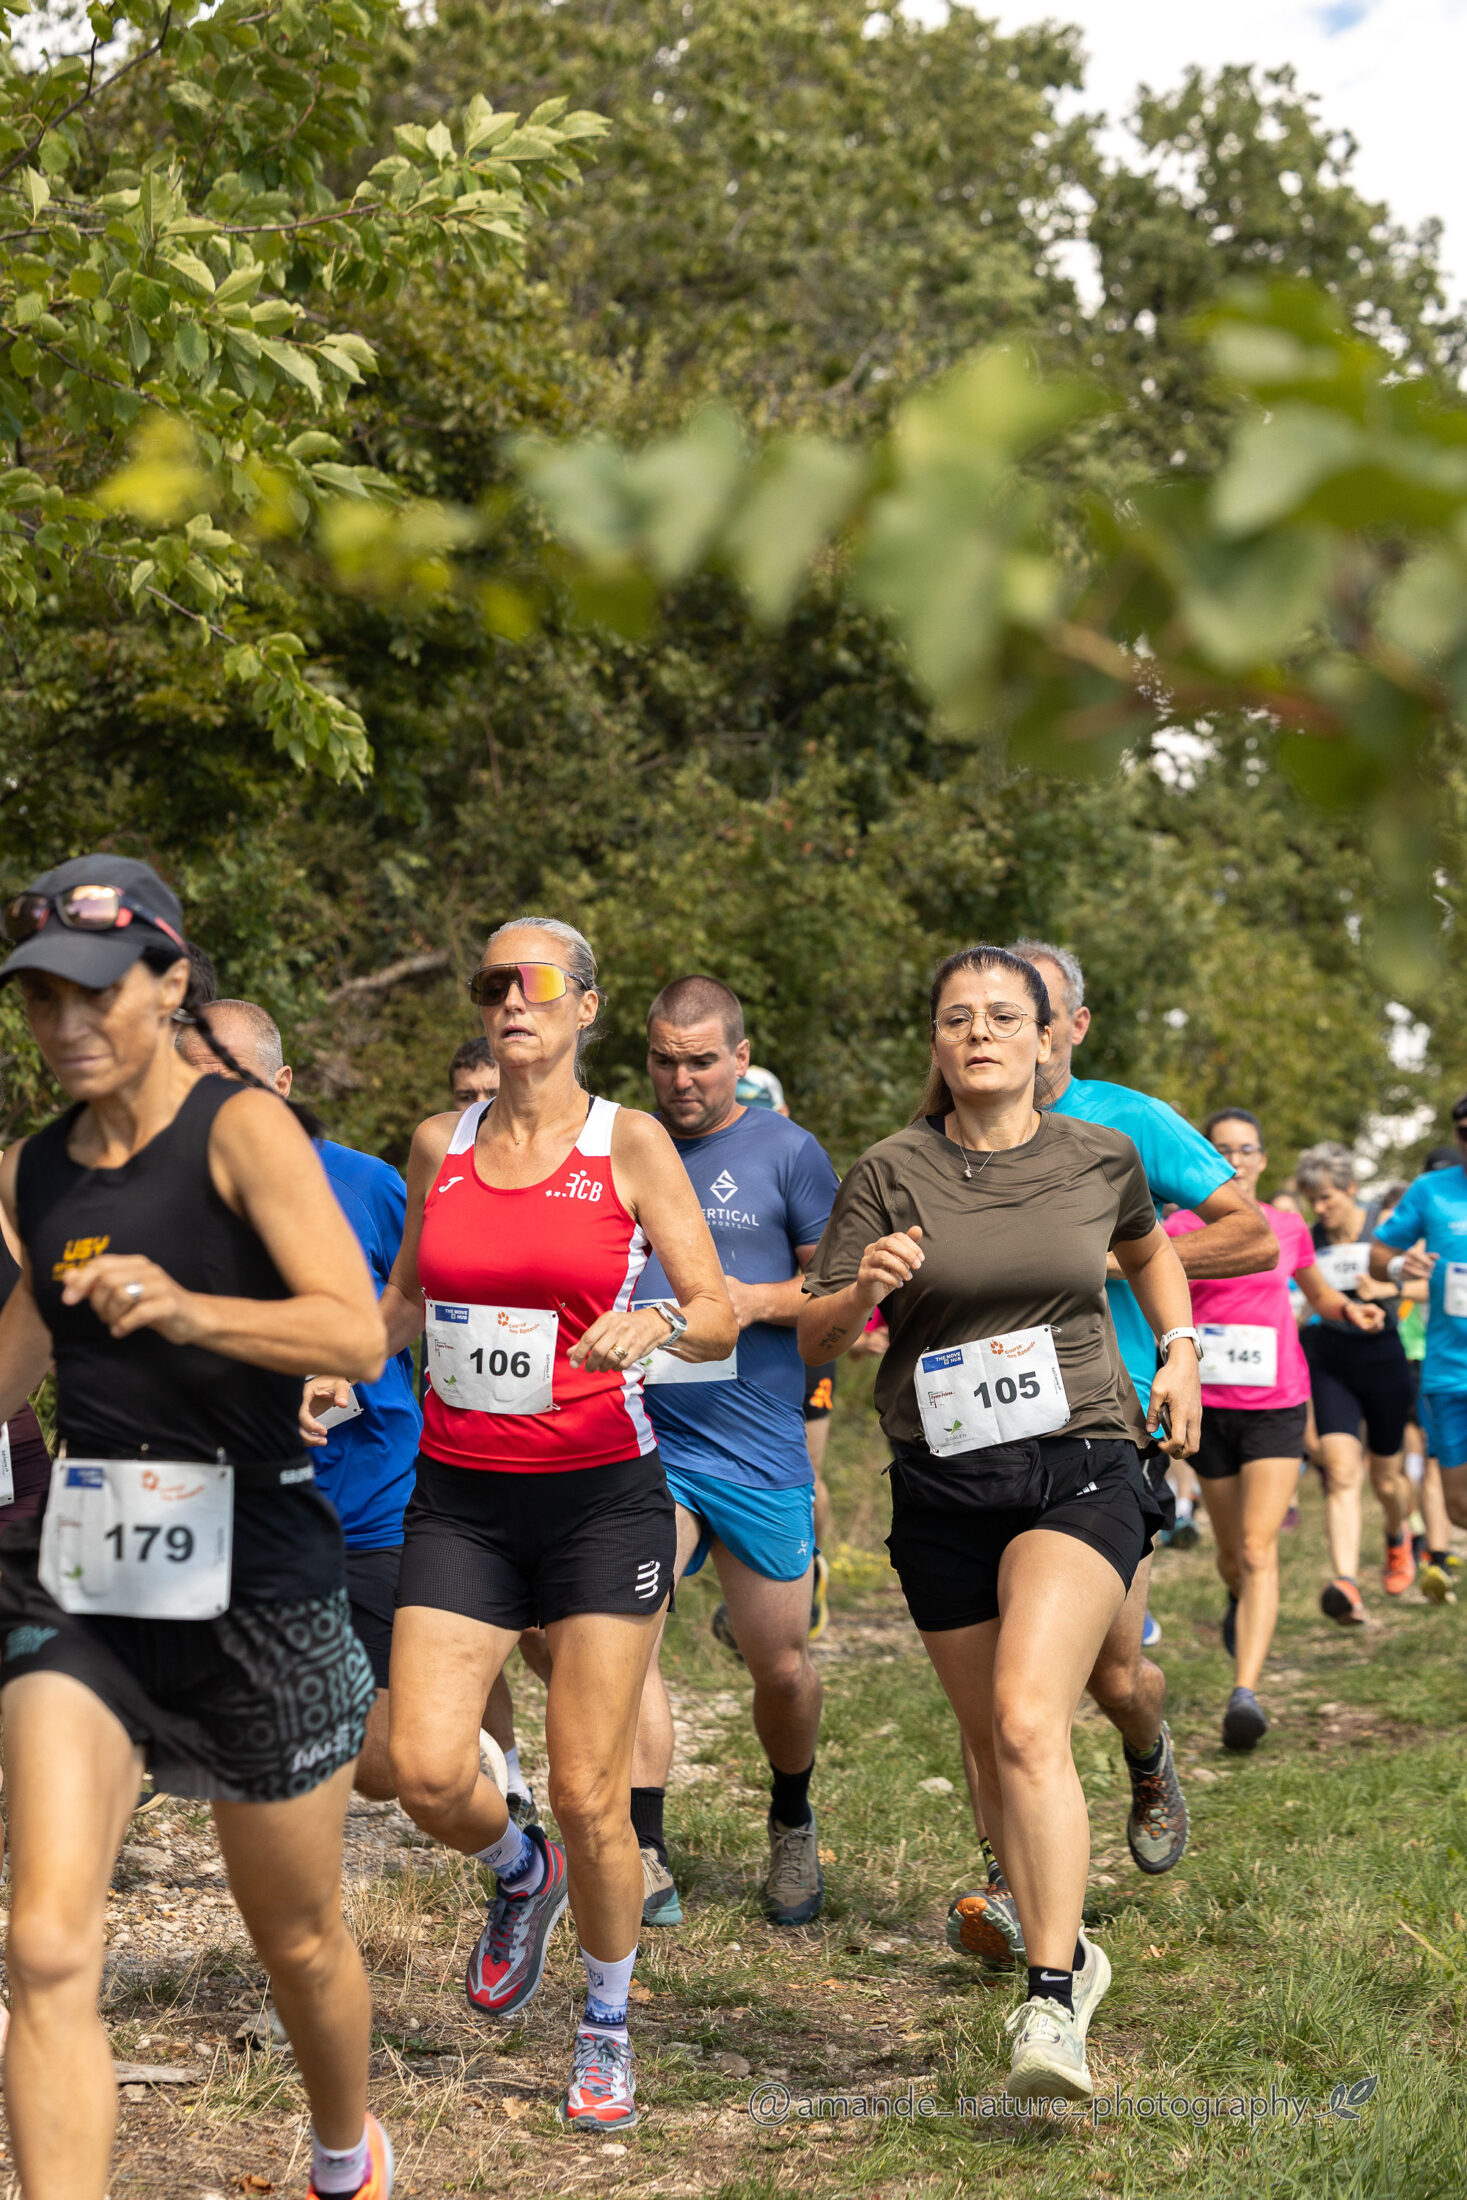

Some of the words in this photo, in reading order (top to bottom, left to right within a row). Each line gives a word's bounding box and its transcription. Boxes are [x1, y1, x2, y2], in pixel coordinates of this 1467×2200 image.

[469, 1347, 531, 1379] 106
[946, 1351, 961, 1359] MOVE
[1227, 1349, 1262, 1364] 145
[973, 1370, 1041, 1409] 105
[104, 1522, 195, 1564] 179
